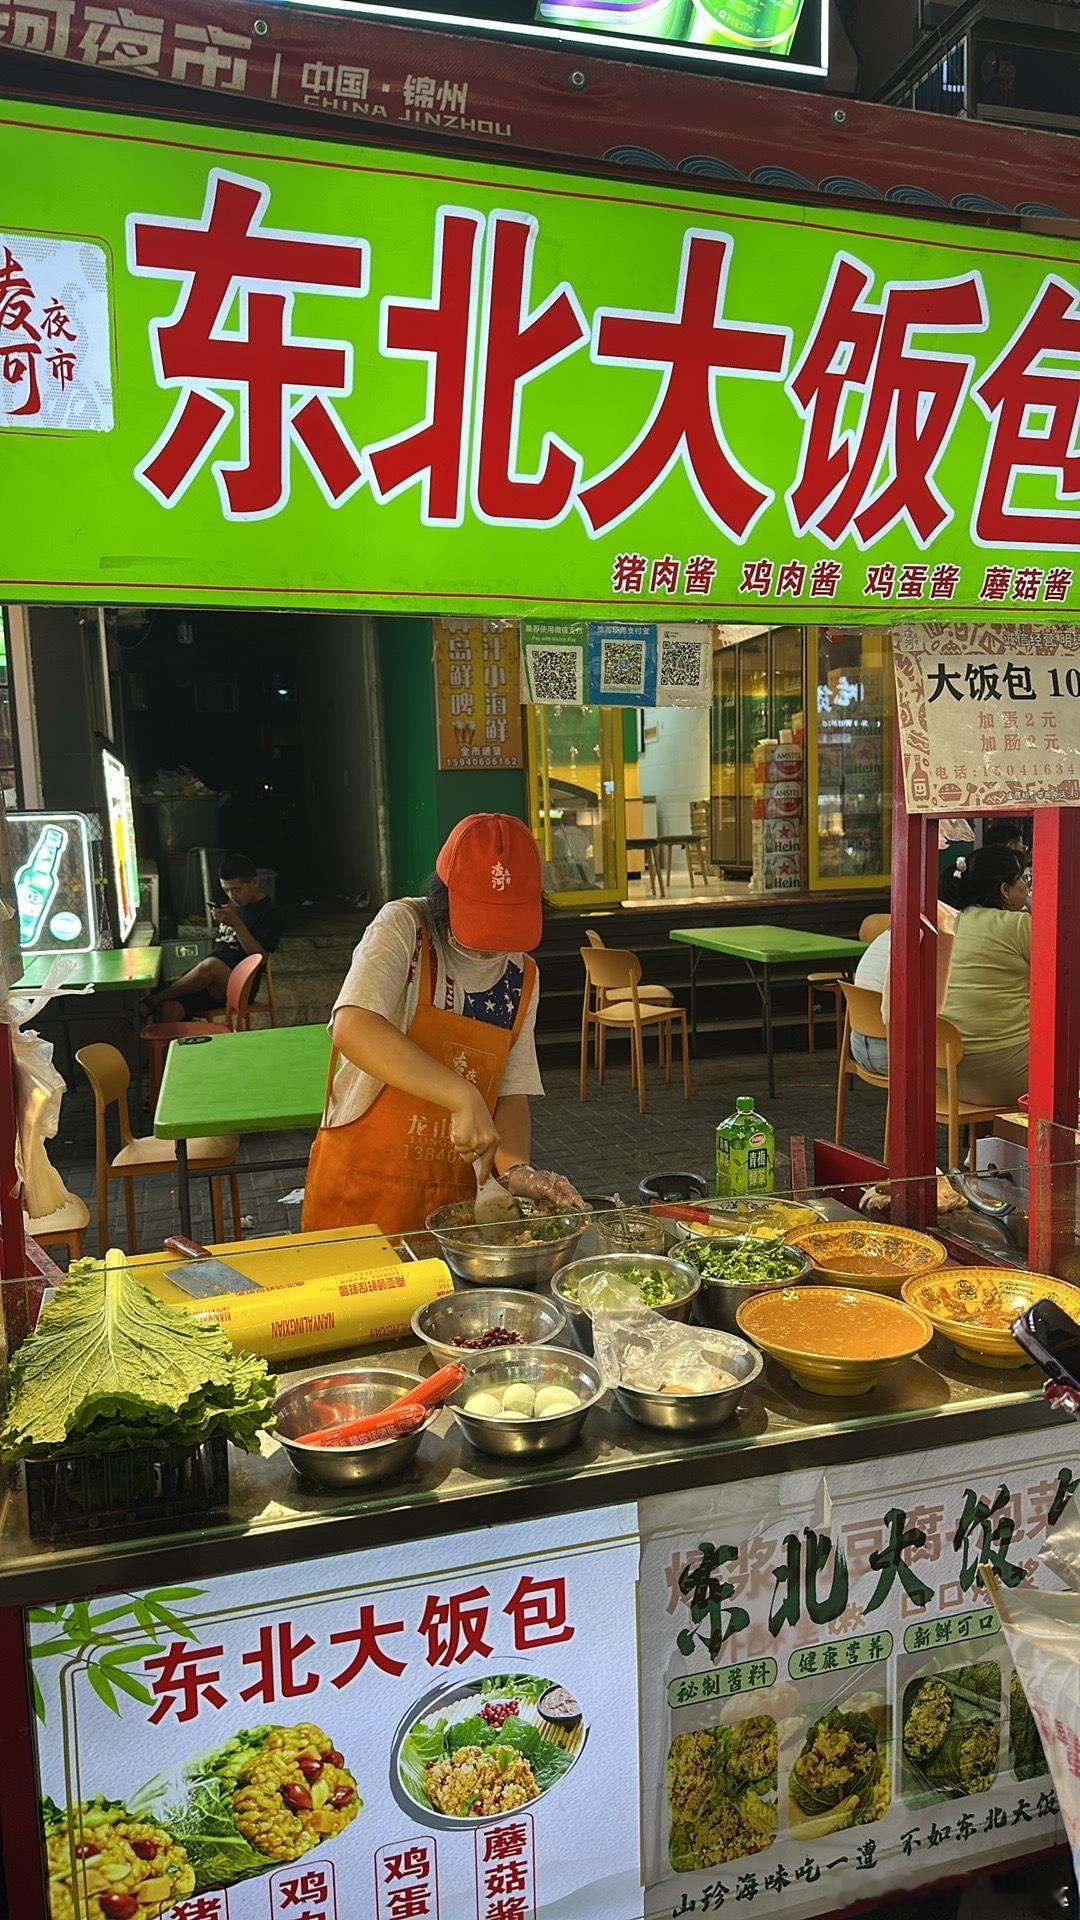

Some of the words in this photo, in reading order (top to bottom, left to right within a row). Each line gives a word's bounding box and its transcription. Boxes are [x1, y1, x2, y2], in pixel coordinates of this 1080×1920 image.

[301, 61, 469, 115] 中国·锦州
[304, 94, 388, 119] CHINA
[398, 109, 512, 137] JINZHOU
[41, 297, 77, 391] 夜市
[129, 168, 1080, 552] 东北大饭包
[612, 554, 717, 595] 猪肉酱
[739, 559, 841, 598] 鸡肉酱
[864, 562, 960, 599] 鸡蛋酱
[979, 566, 1073, 602] 蘑菇酱
[927, 662, 1037, 704] 大饭包
[403, 1143, 463, 1164] 13840
[145, 1574, 575, 1726] 东北大饭包
[798, 1634, 883, 1673] 健康营养
[913, 1614, 994, 1649] 新鲜可口
[676, 1661, 771, 1703] 秘制酱料
[280, 1870, 329, 1920] 鸡
